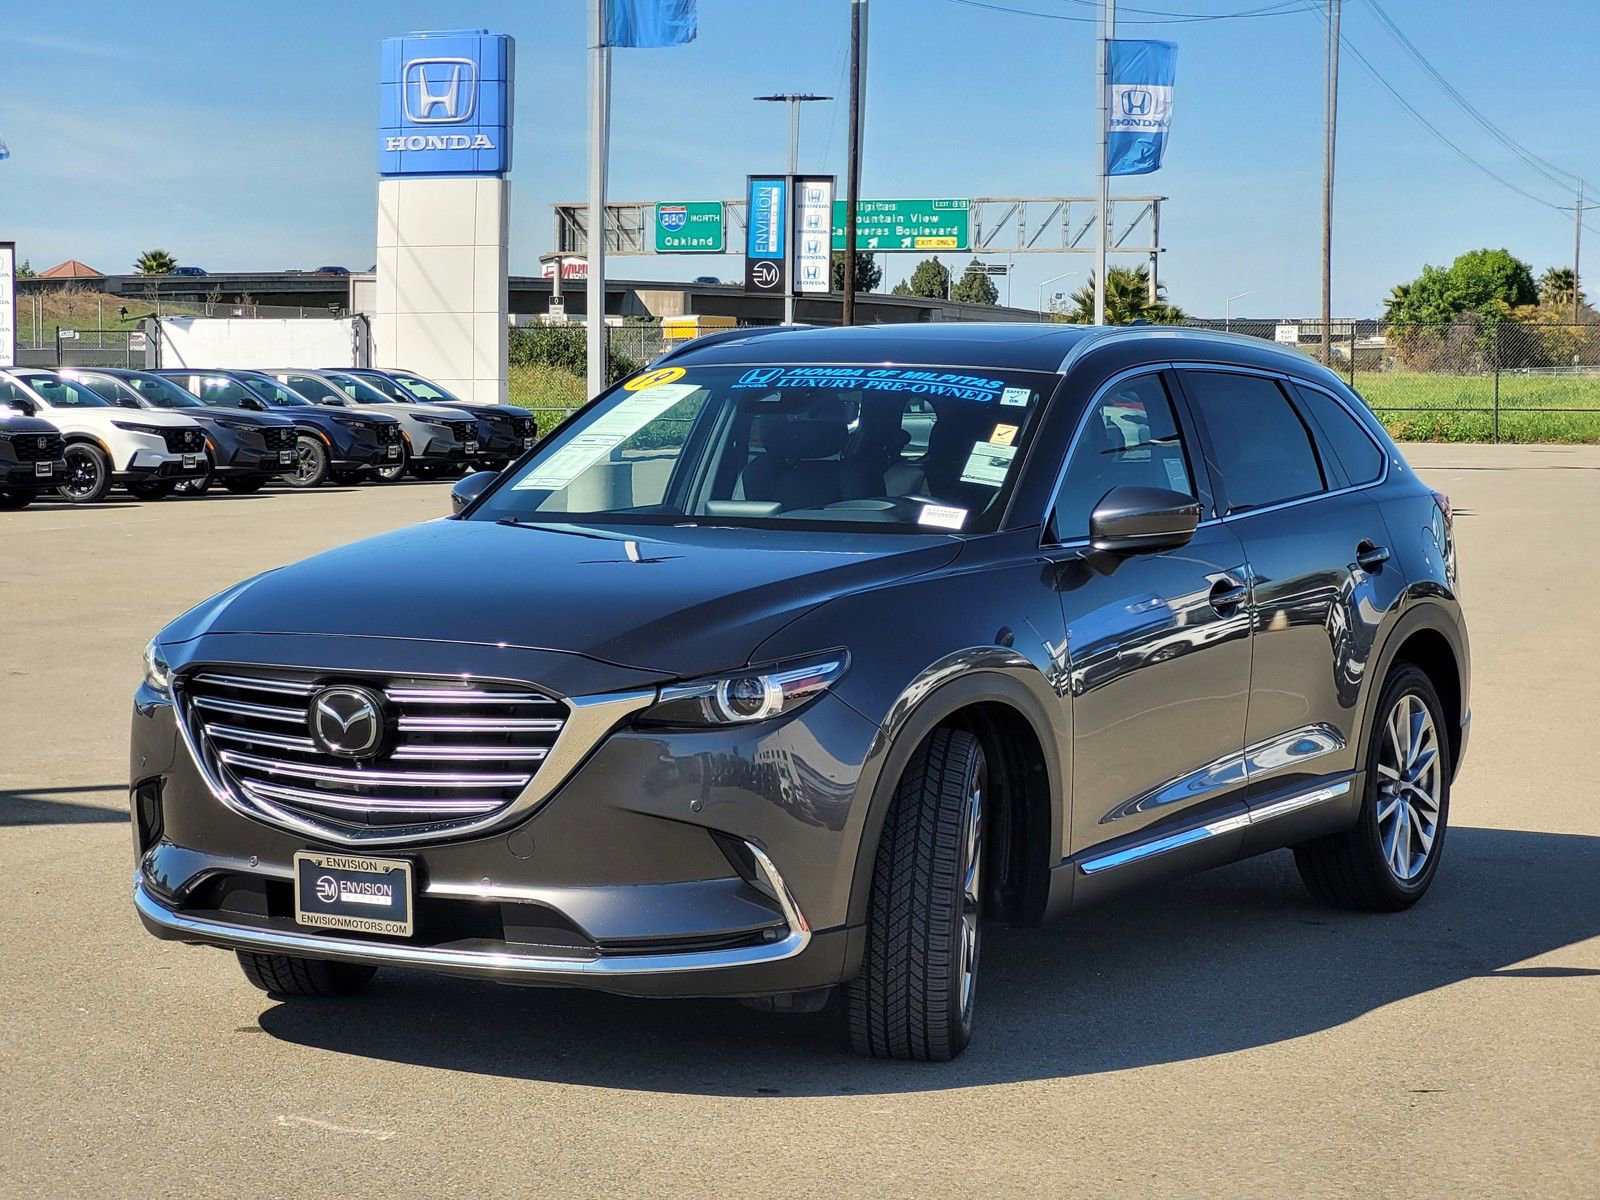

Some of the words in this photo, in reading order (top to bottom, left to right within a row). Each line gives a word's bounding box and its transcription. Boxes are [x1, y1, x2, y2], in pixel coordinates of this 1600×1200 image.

[1110, 118, 1162, 128] HONDA
[386, 134, 496, 151] HONDA
[856, 201, 896, 213] ilpitas
[690, 214, 720, 222] NORTH
[755, 187, 772, 252] ENVISION
[856, 215, 904, 223] ountain
[910, 213, 939, 223] View
[832, 226, 889, 236] alveras
[895, 225, 958, 236] Boulevard
[664, 236, 713, 246] Oakland
[787, 368, 865, 376] HONDA
[867, 369, 902, 377] OF
[898, 371, 1005, 389] MILPITAS
[776, 378, 864, 388] LUXURY
[862, 380, 994, 402] PRE-OWNED
[326, 857, 378, 871] ENVISION
[340, 881, 392, 896] ENVISION
[301, 914, 407, 934] ENVISIONMOTORS.COM
